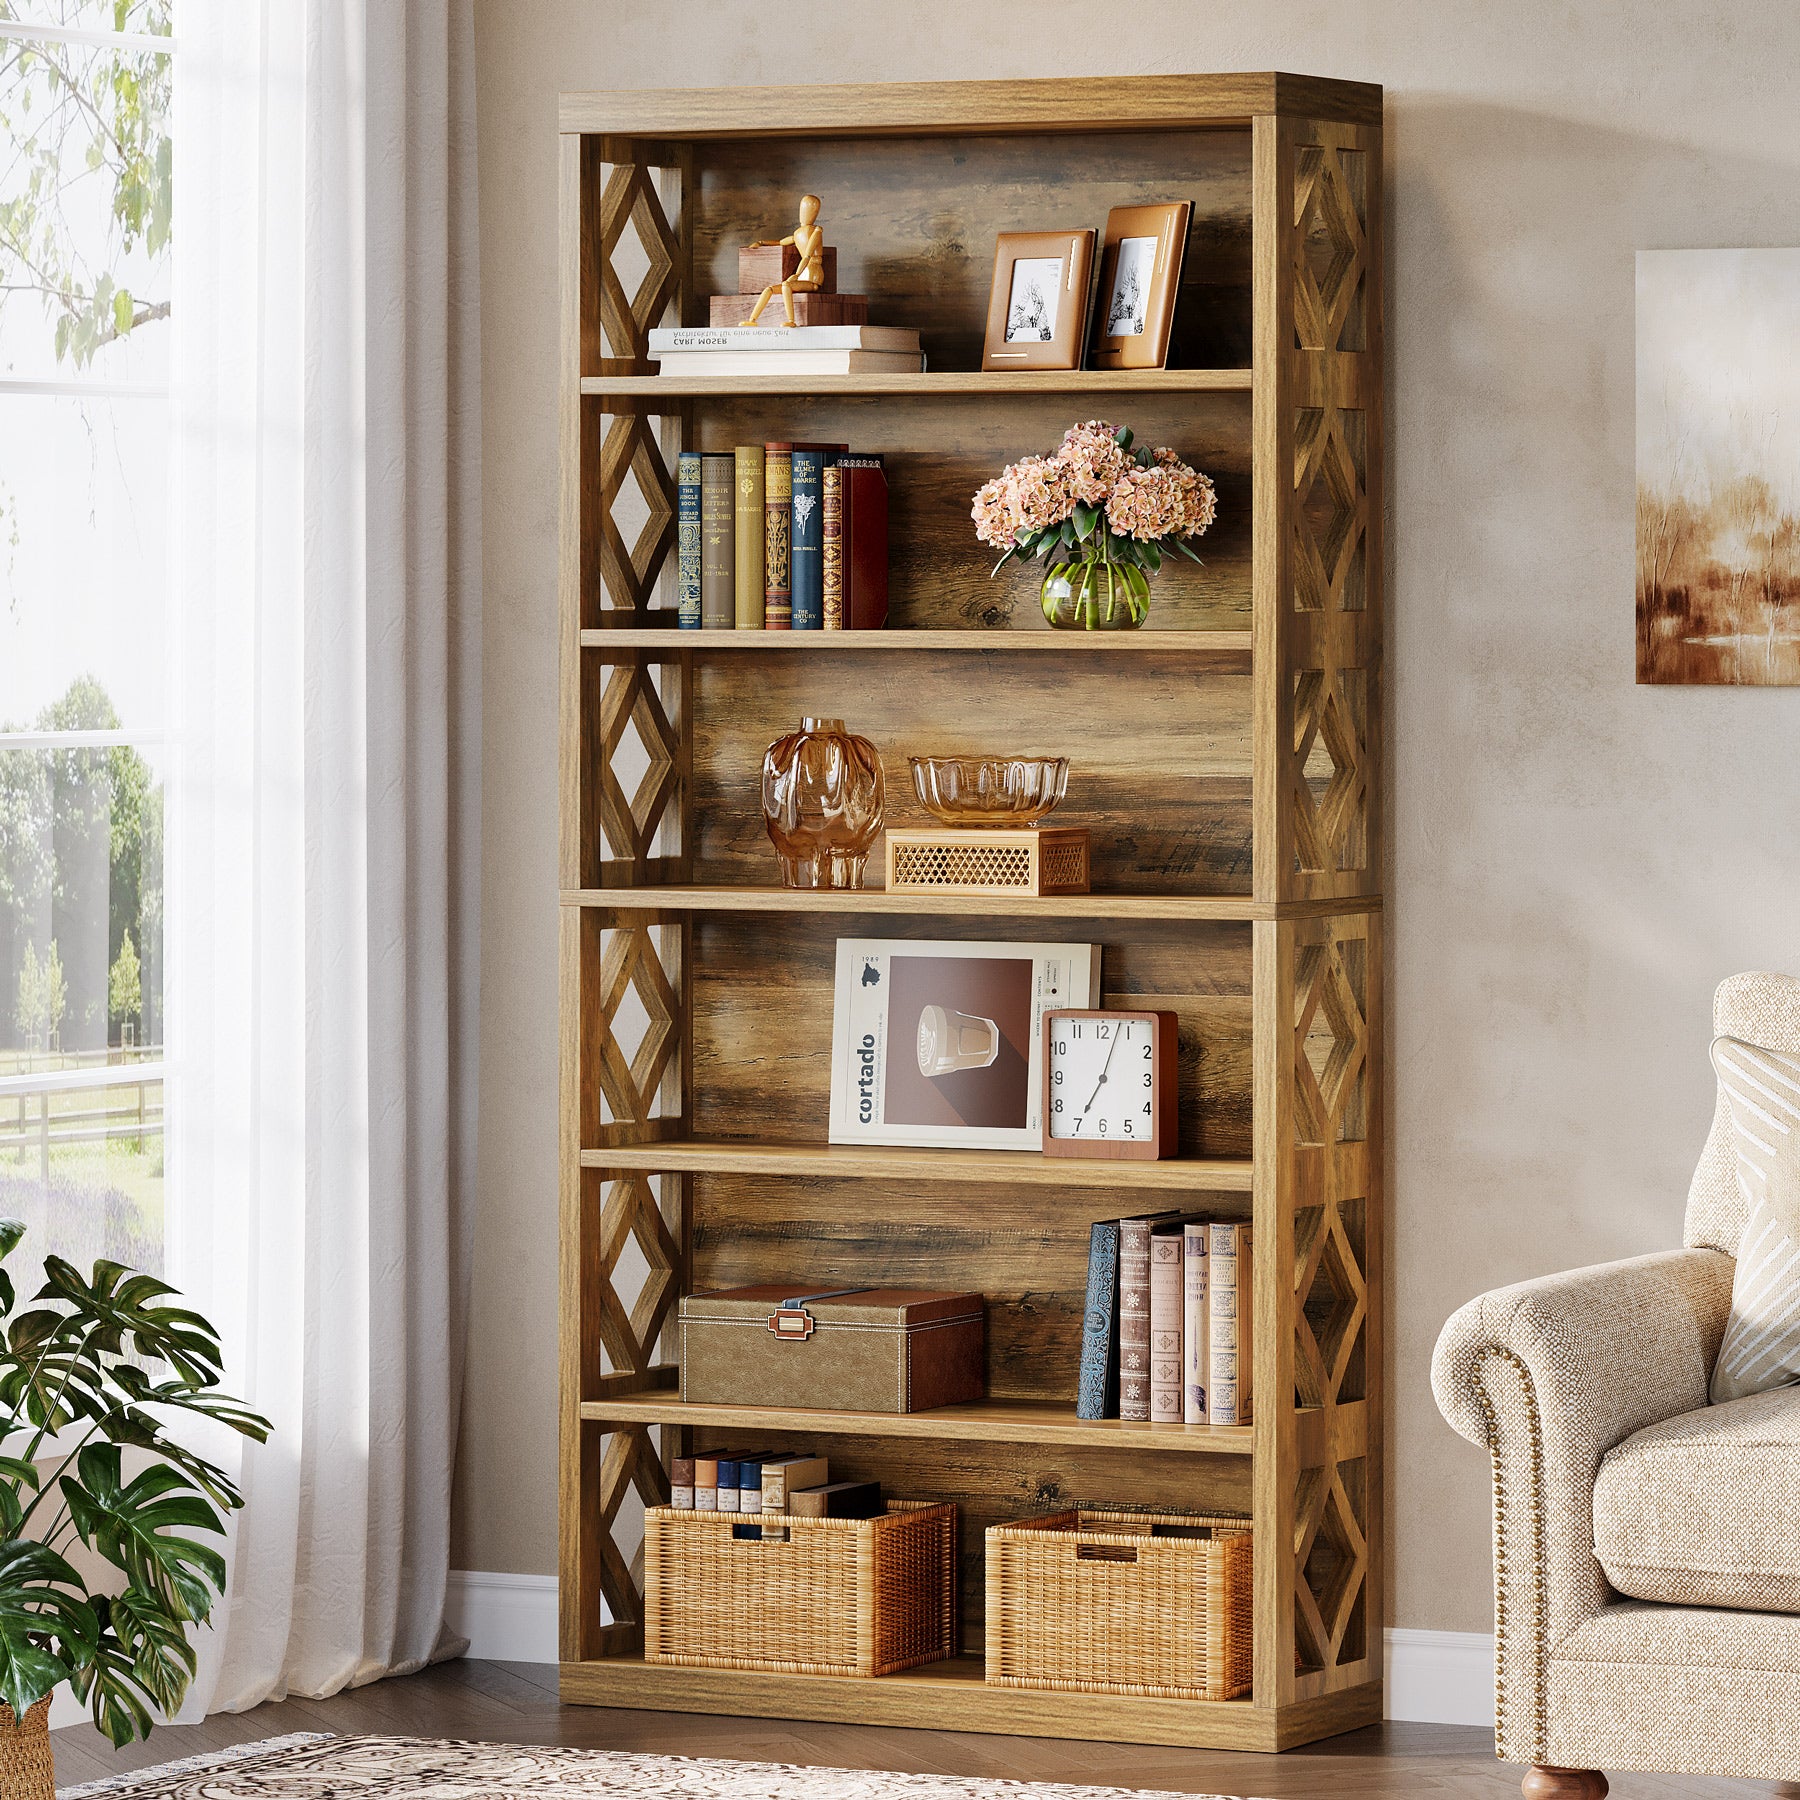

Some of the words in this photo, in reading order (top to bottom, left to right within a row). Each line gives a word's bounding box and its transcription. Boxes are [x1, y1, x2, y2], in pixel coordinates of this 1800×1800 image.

[1072, 1025, 1082, 1039] 11
[1096, 1025, 1110, 1040] 12
[1126, 1026, 1130, 1040] 1
[1054, 1041, 1067, 1056] 10
[1143, 1045, 1152, 1060] 2
[856, 1034, 875, 1124] cortado
[1054, 1071, 1063, 1085] 9
[1143, 1073, 1152, 1088] 3
[1054, 1099, 1064, 1113] 8
[1142, 1102, 1152, 1116] 4
[1073, 1118, 1083, 1132] 7
[1098, 1119, 1108, 1133] 6
[1123, 1119, 1133, 1134] 5
